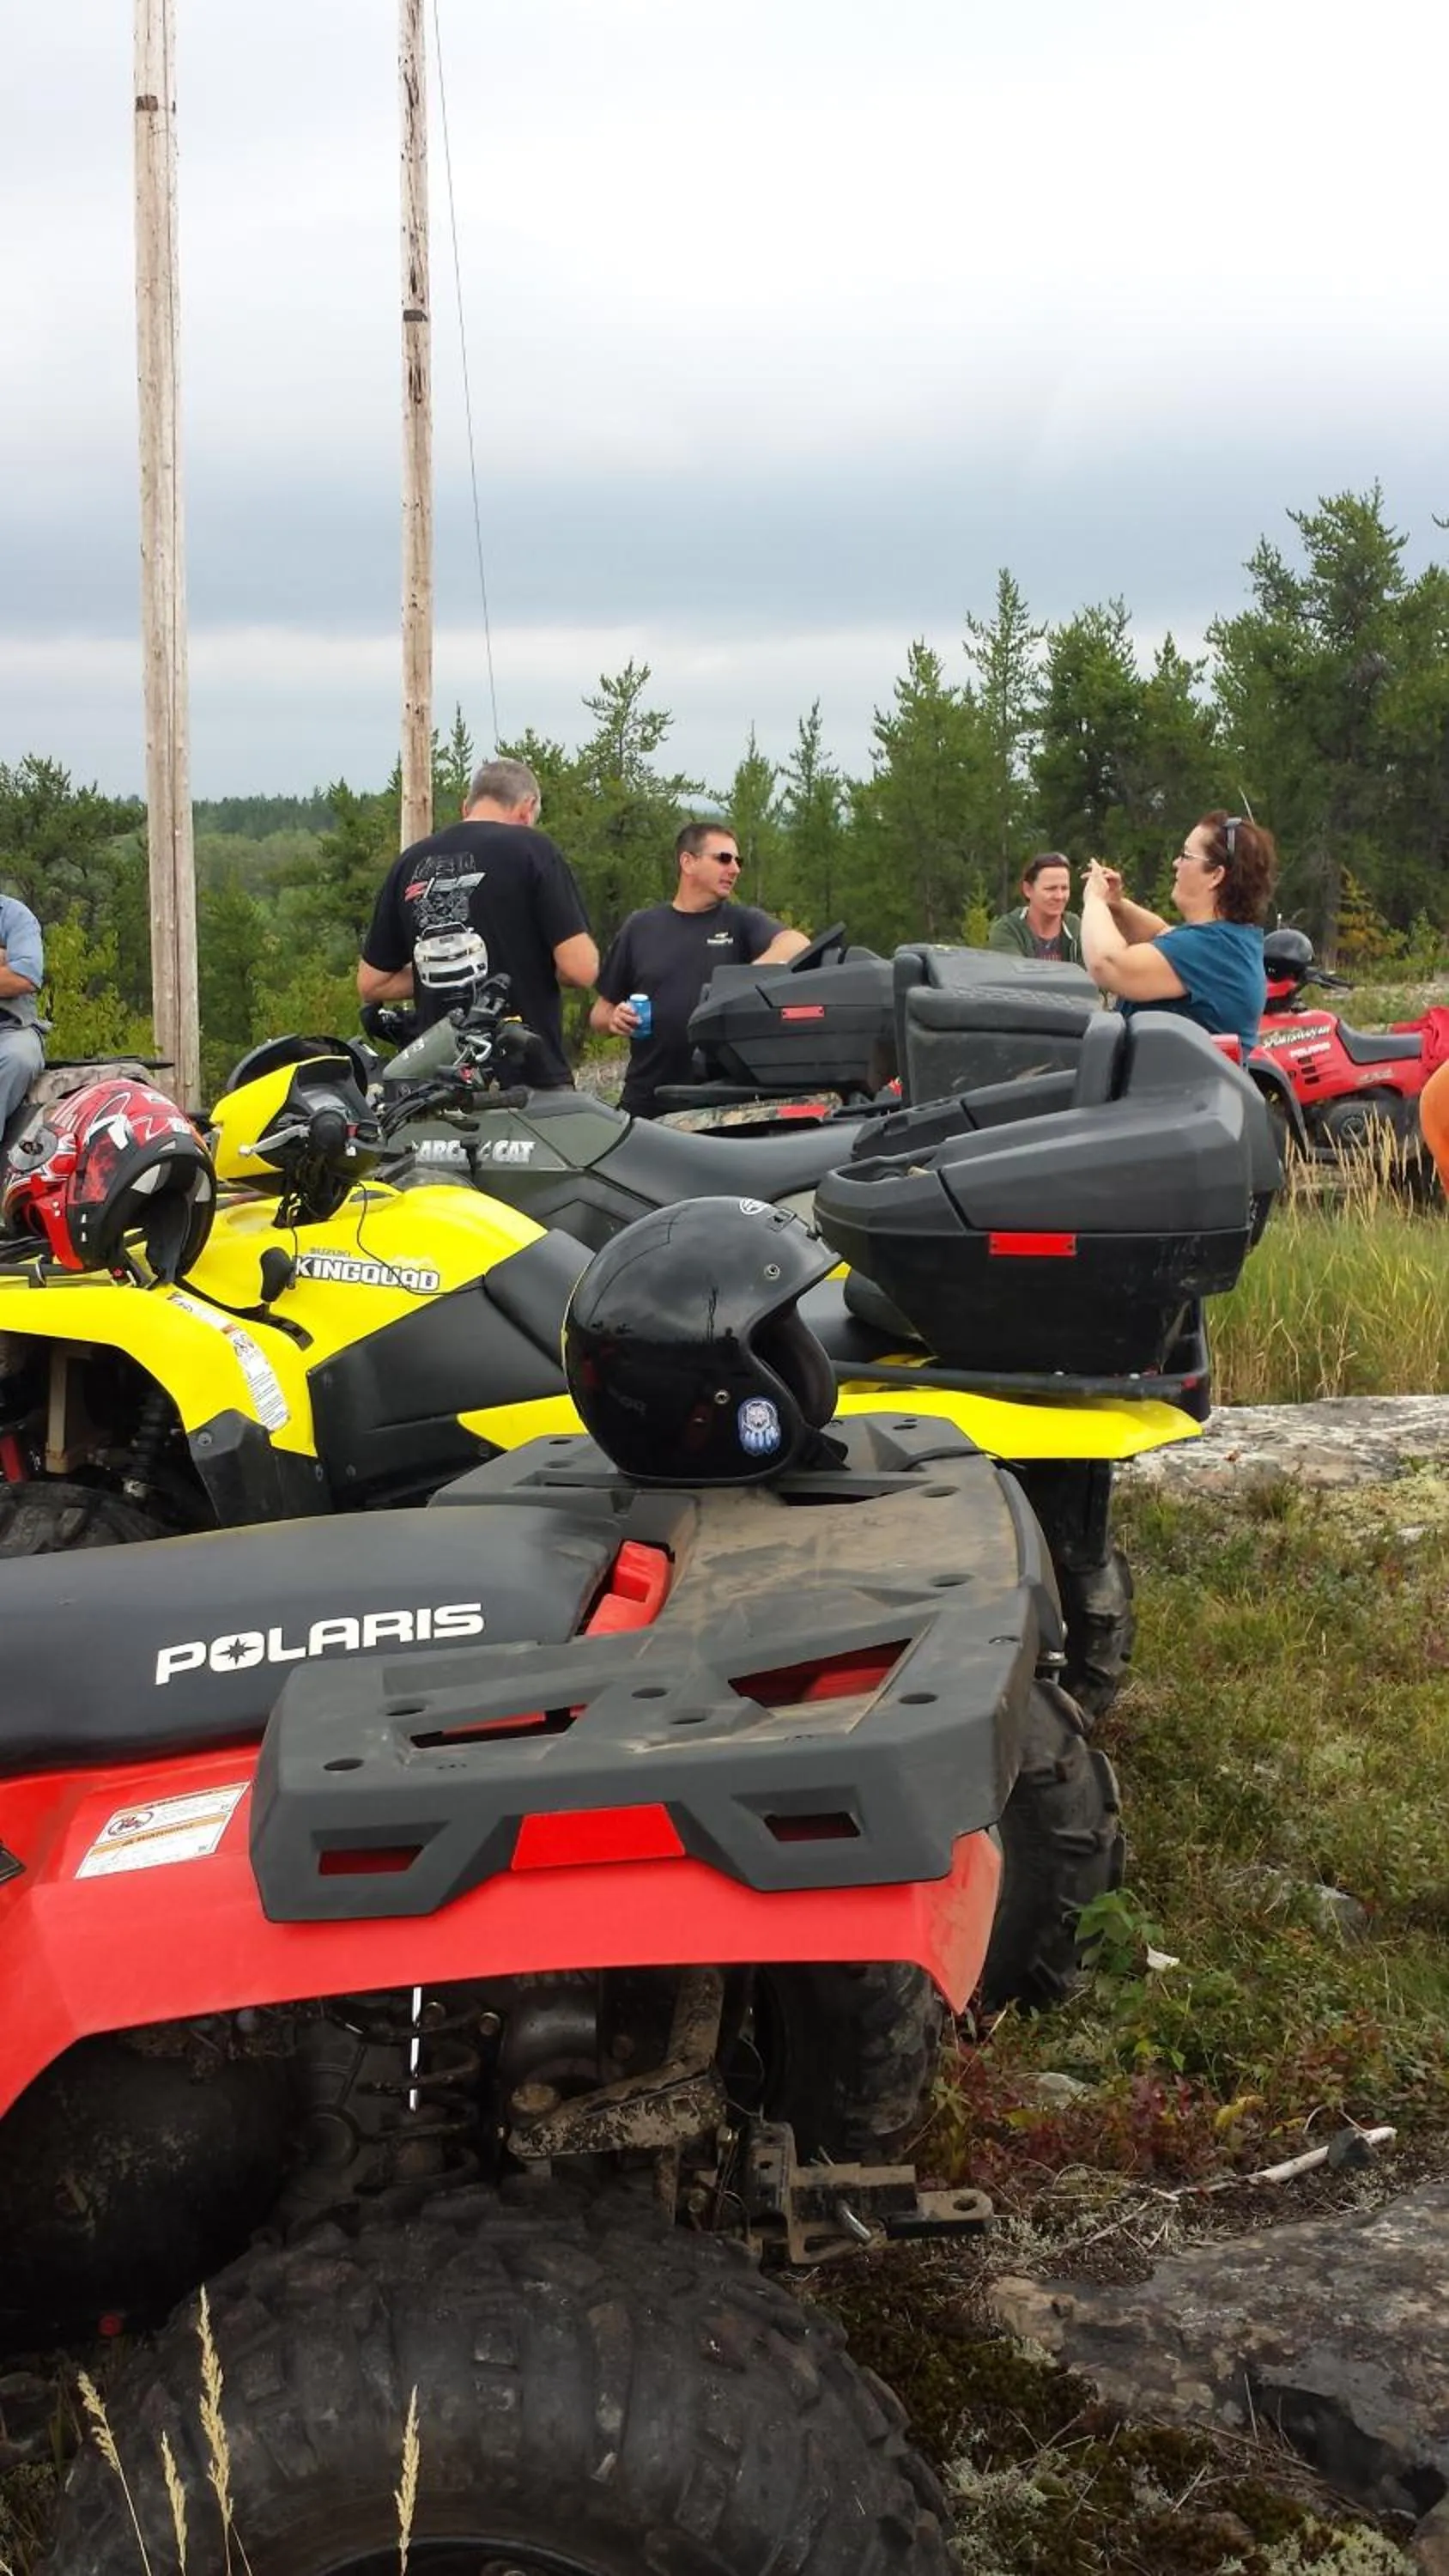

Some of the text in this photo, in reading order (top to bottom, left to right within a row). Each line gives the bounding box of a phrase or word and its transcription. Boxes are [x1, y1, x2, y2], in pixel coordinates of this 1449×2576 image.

[415, 1139, 536, 1162] ARCC CAT
[294, 1256, 440, 1291] KINGQUAD
[155, 1603, 483, 1686] POLARIS
